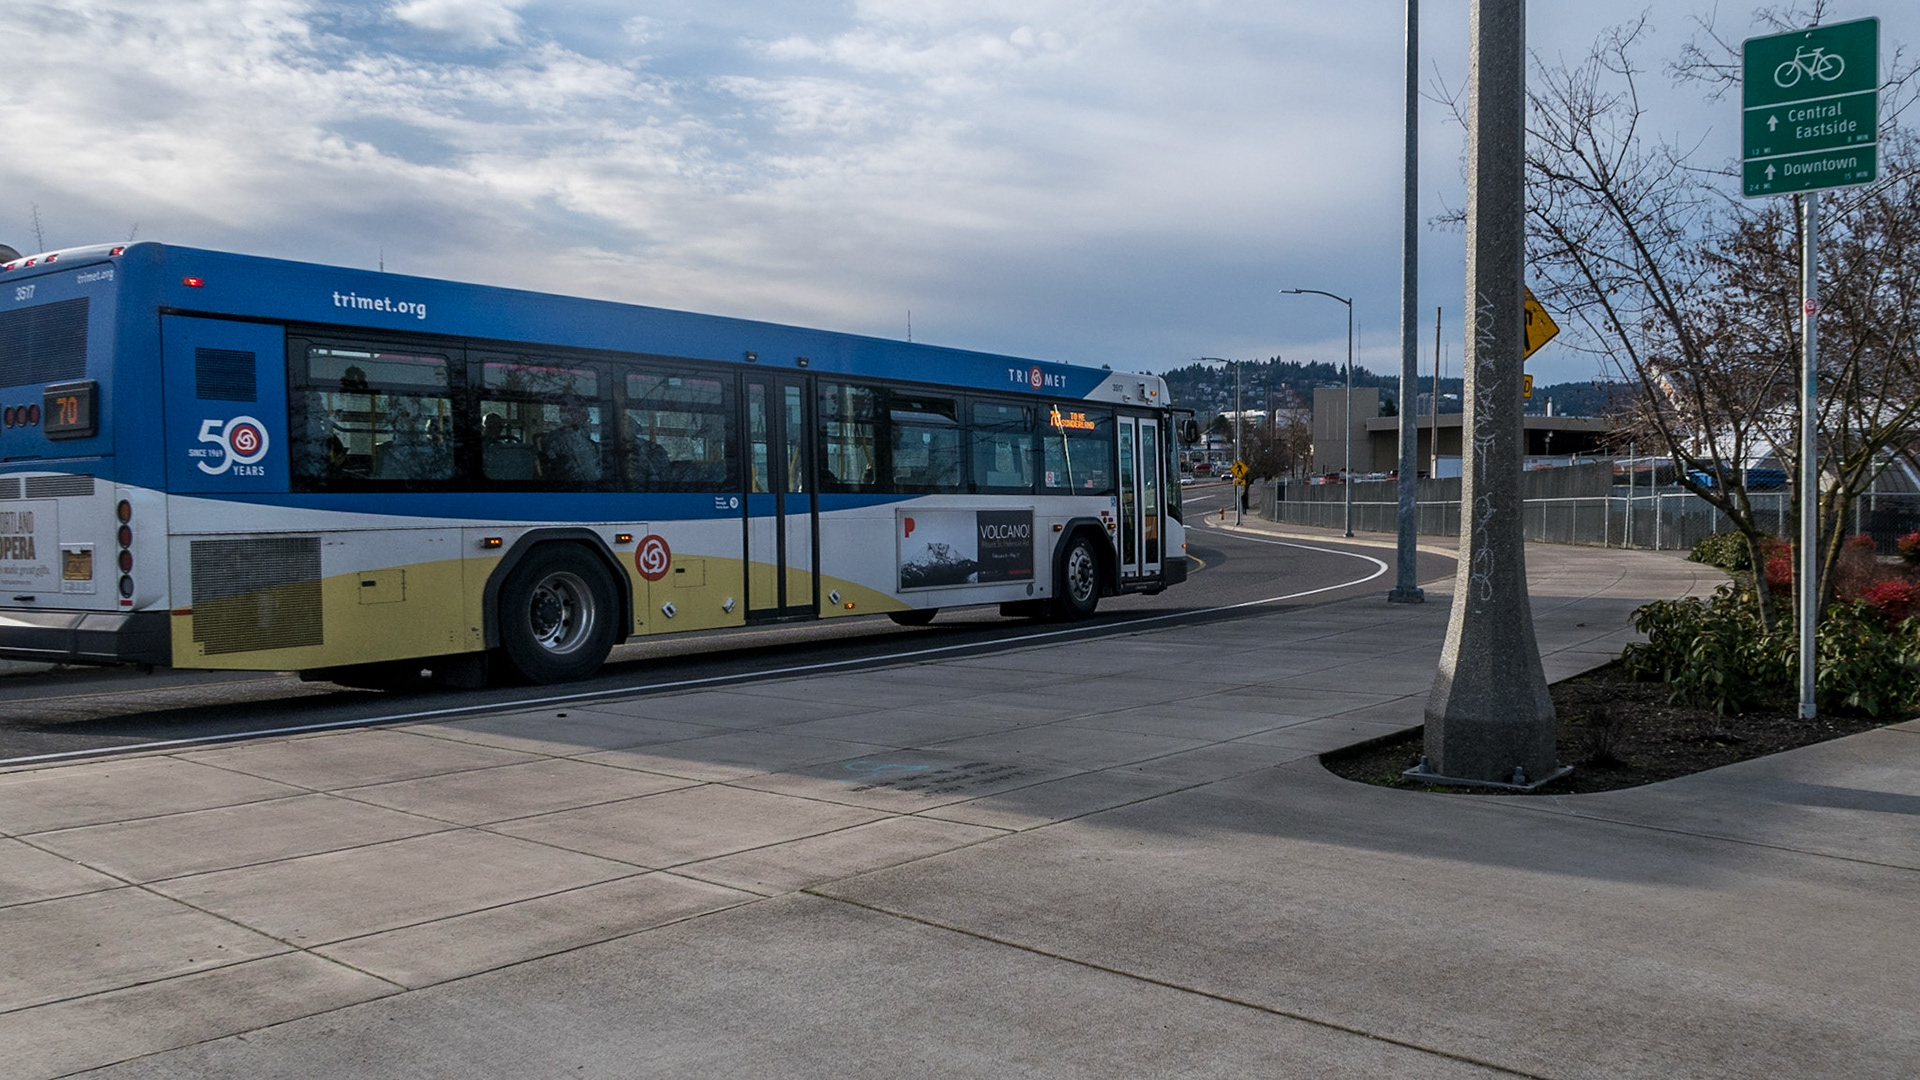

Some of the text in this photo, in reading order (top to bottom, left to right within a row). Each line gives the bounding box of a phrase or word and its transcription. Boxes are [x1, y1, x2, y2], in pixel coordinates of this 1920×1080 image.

[1788, 102, 1842, 122] Central
[1796, 119, 1857, 139] Eastside
[1784, 157, 1857, 176] Downtown
[15, 284, 36, 301] 3517
[332, 291, 426, 320] trimet.org
[1008, 369, 1066, 388] TRI MET
[56, 396, 79, 426] 70
[188, 449, 224, 457] SINCE 1969
[197, 415, 270, 475] 50
[232, 465, 265, 476] YEARS
[980, 524, 1030, 539] VOLCANO!
